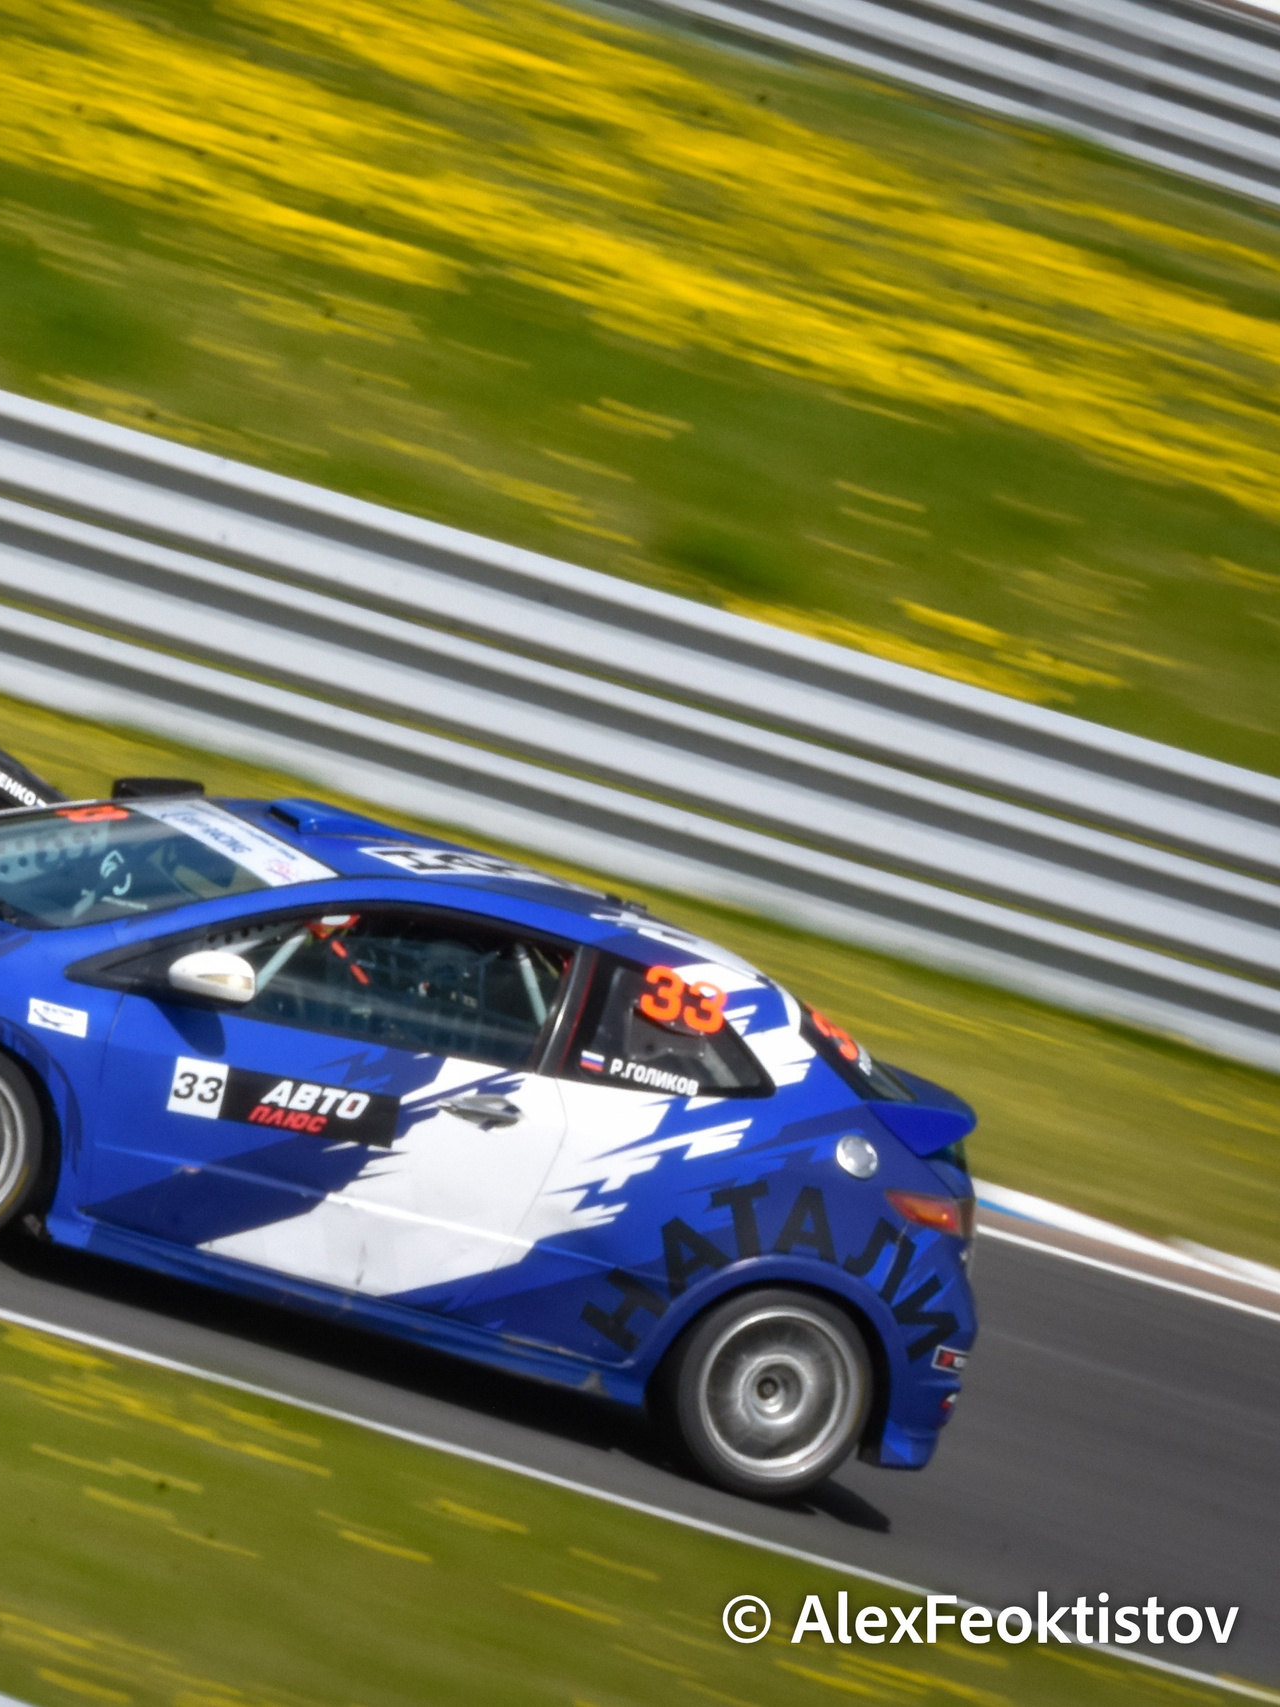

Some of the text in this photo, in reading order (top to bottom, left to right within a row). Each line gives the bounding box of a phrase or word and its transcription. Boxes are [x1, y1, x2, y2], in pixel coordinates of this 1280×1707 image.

[639, 964, 728, 1034] 33
[173, 1072, 224, 1104] 33
[609, 1057, 700, 1097] Р.ГОЛИКОВ
[247, 1104, 329, 1134] ПЛЮС
[259, 1079, 371, 1121] АВТО
[580, 1180, 960, 1364] НАТАЛИ
